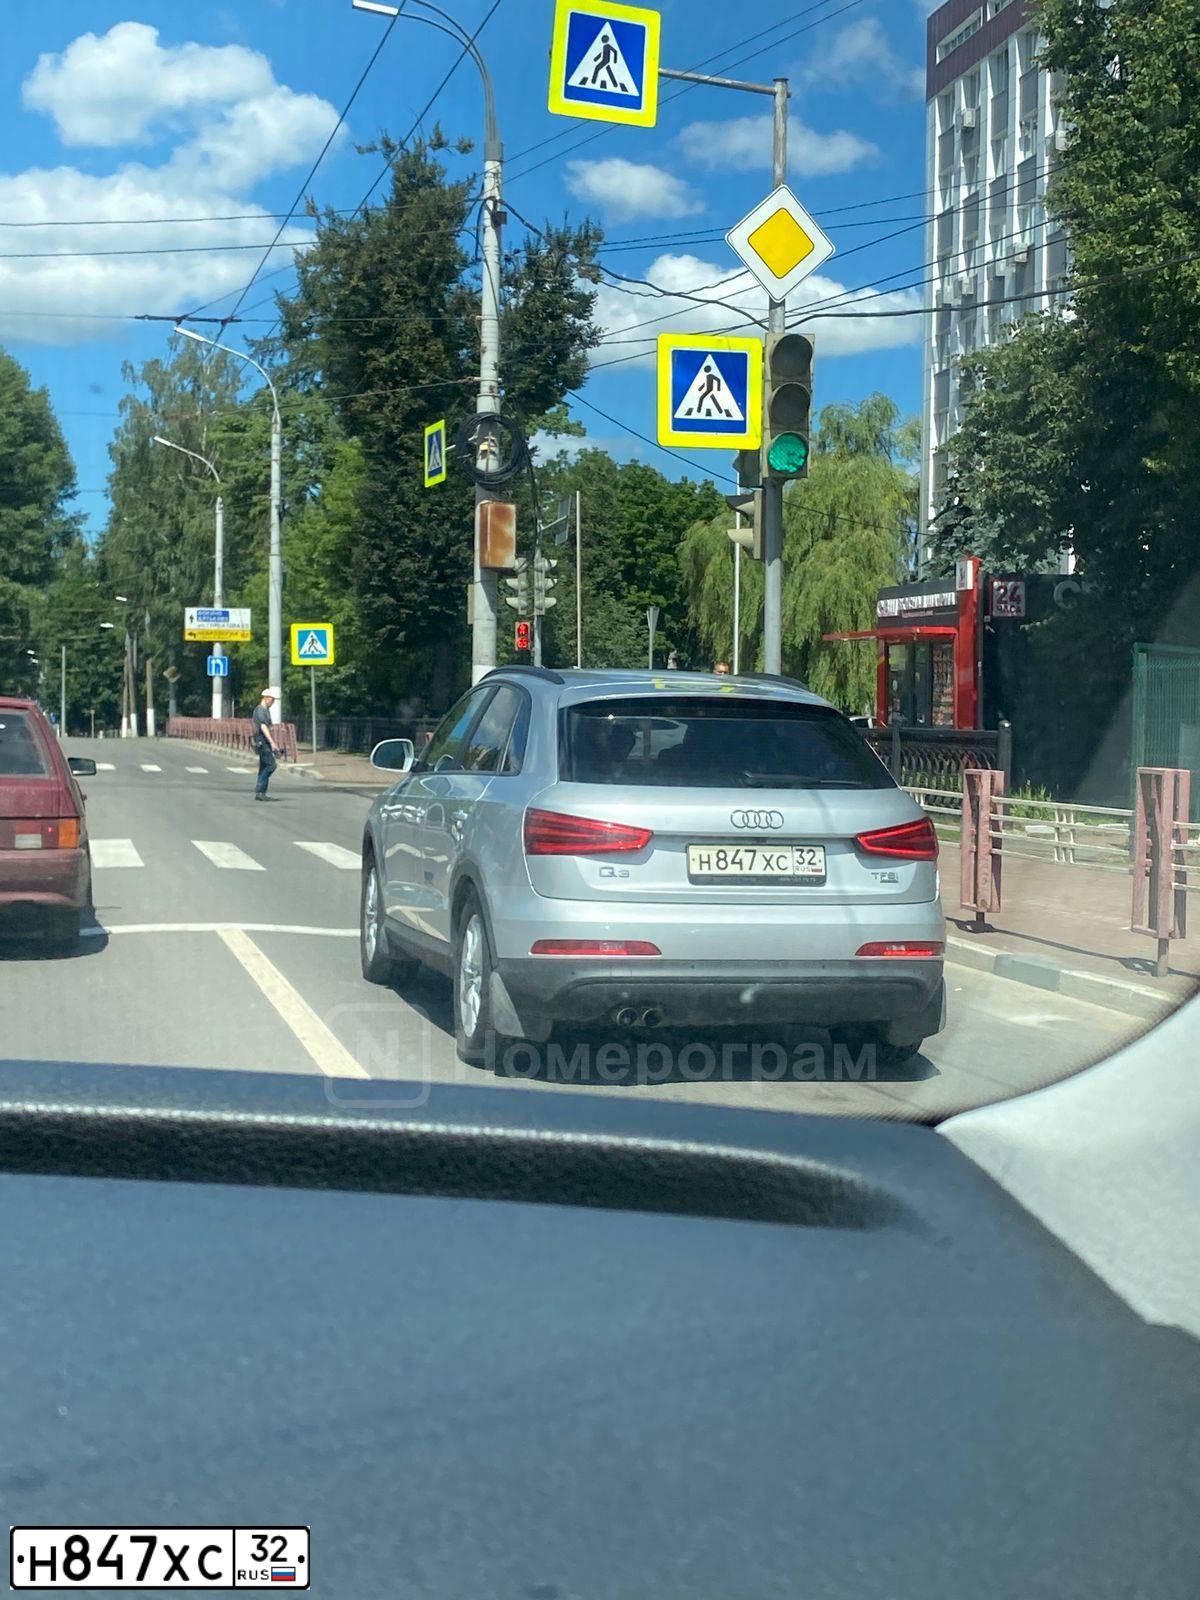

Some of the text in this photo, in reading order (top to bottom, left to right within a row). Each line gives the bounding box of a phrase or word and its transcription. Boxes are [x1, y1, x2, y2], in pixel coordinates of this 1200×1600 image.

[997, 584, 1021, 604] 24
[699, 848, 817, 871] Н847ХС 32
[599, 866, 630, 878] Q3
[794, 865, 811, 873] RUS
